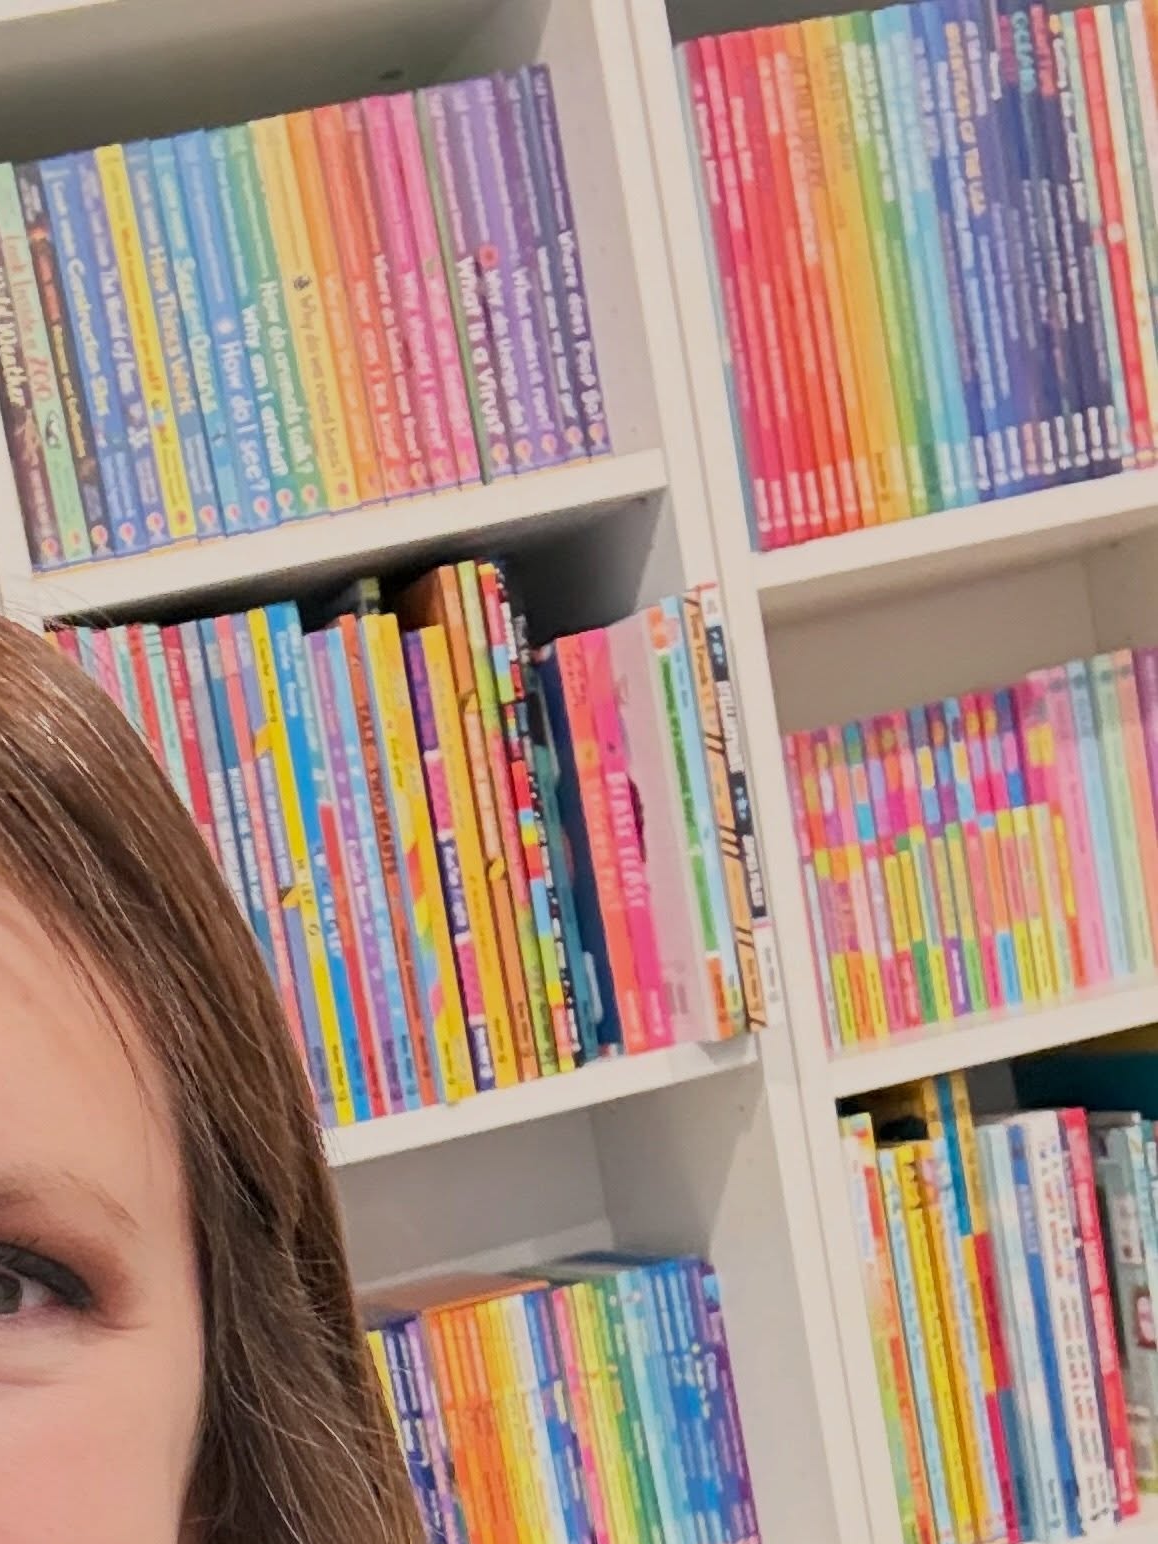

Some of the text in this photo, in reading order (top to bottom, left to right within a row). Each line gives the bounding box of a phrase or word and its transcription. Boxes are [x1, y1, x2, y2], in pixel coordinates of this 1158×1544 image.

[266, 324, 289, 350] do
[454, 256, 482, 317] What
[471, 346, 488, 364] a
[219, 340, 270, 493] How do I see?
